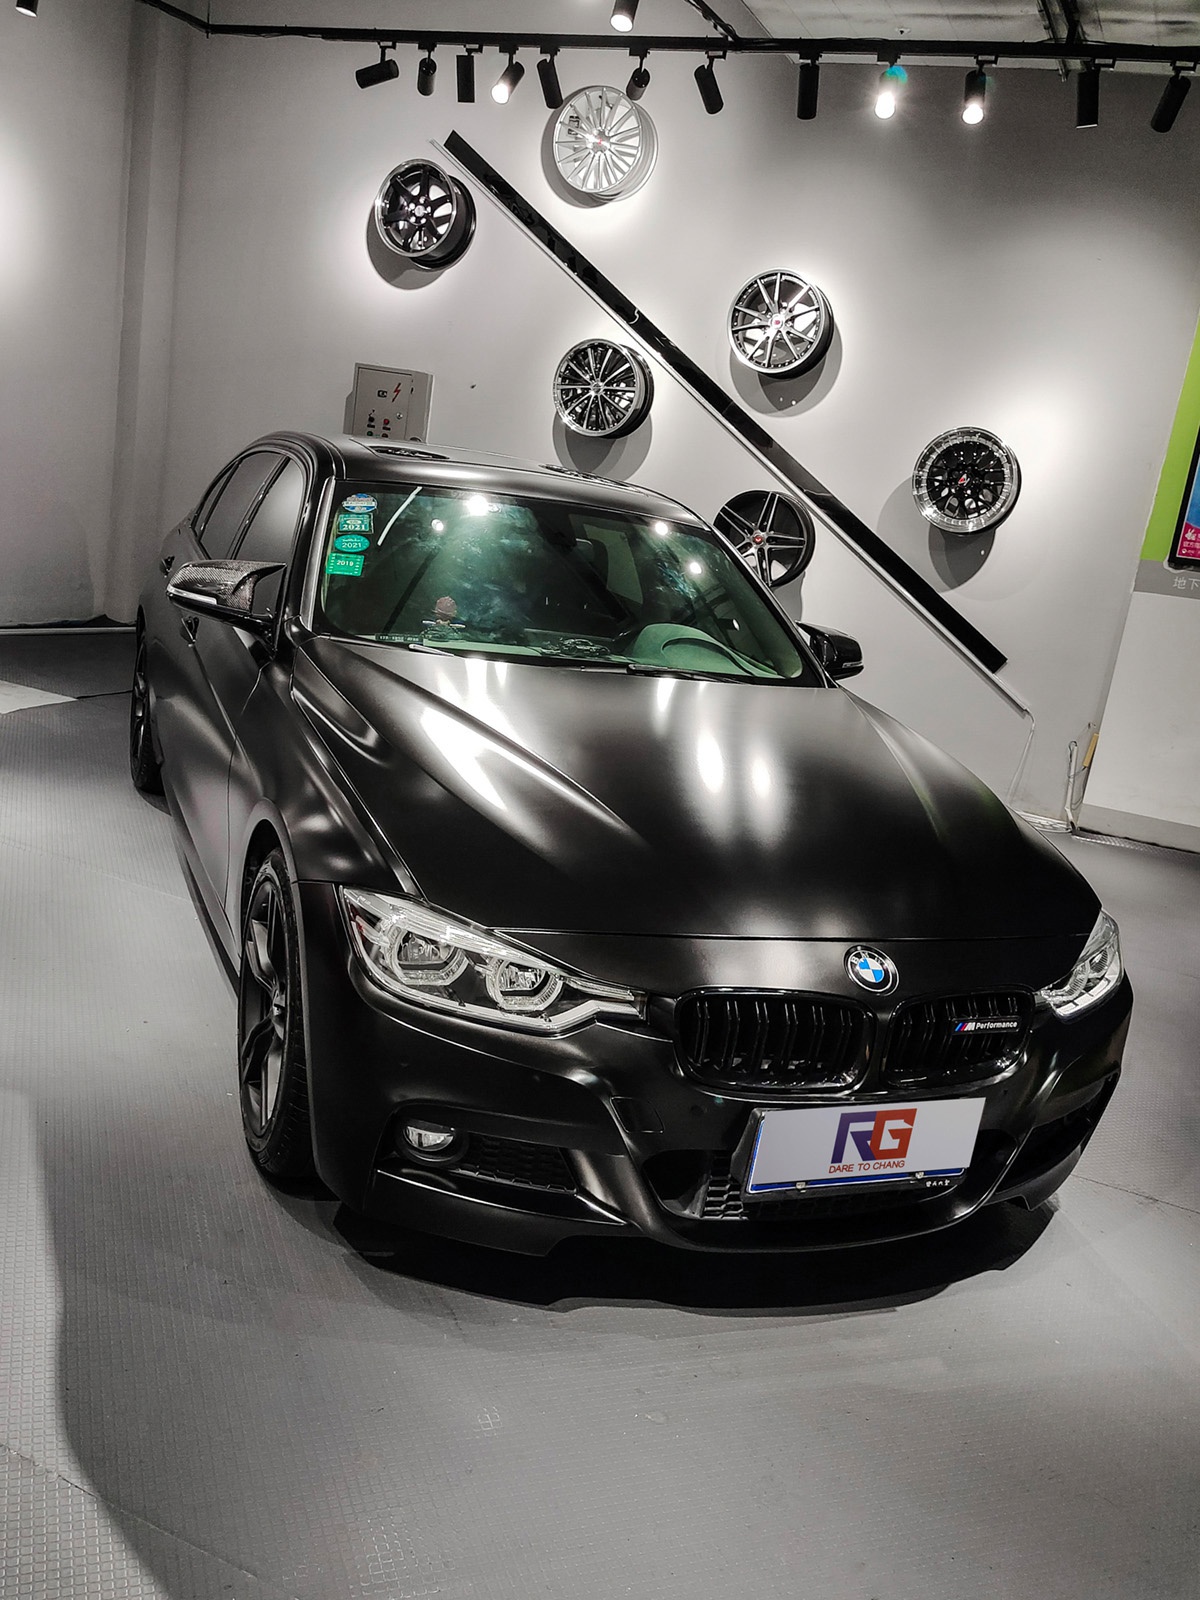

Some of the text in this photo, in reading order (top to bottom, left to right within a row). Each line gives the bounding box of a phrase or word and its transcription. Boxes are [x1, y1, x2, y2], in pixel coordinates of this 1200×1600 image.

[1173, 576, 1200, 591] 地下
[976, 1021, 1018, 1030] Performance
[830, 1108, 918, 1164] RG
[828, 1159, 906, 1174] DARE TO CHANG
